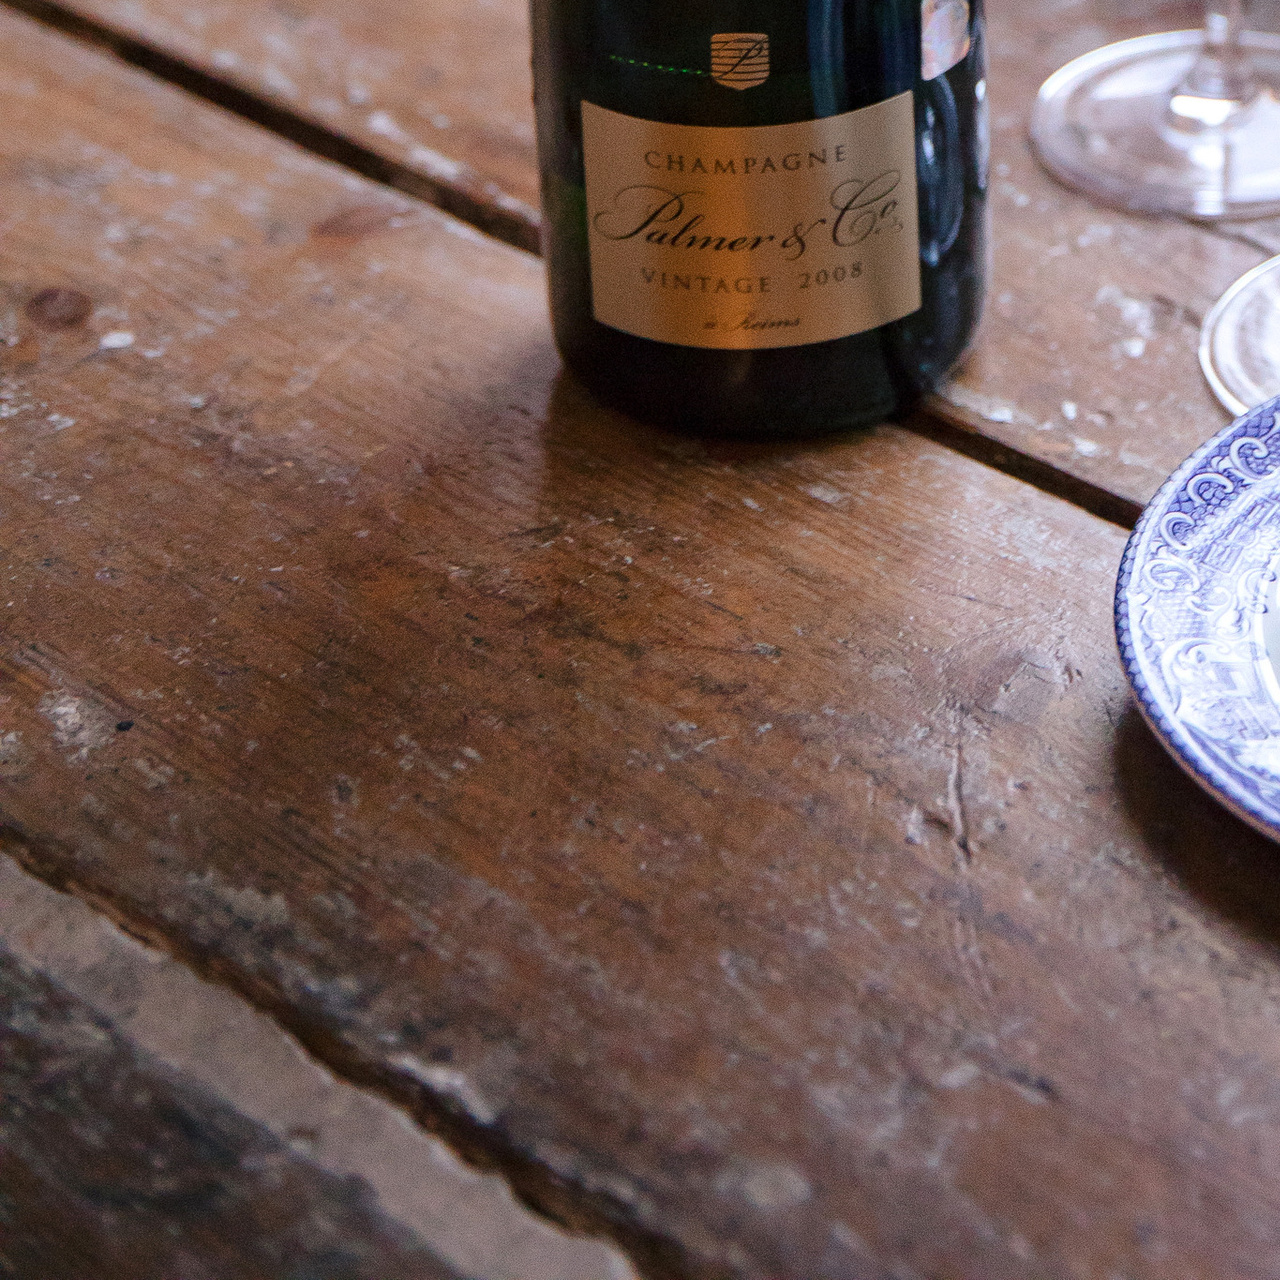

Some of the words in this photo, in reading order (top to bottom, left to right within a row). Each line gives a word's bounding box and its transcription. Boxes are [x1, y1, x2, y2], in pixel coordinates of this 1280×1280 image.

[643, 144, 848, 175] CHAMPAGNE
[593, 184, 775, 251] Palmer
[781, 216, 827, 261] &
[640, 267, 772, 294] VINTAGE
[799, 260, 864, 290] 2008
